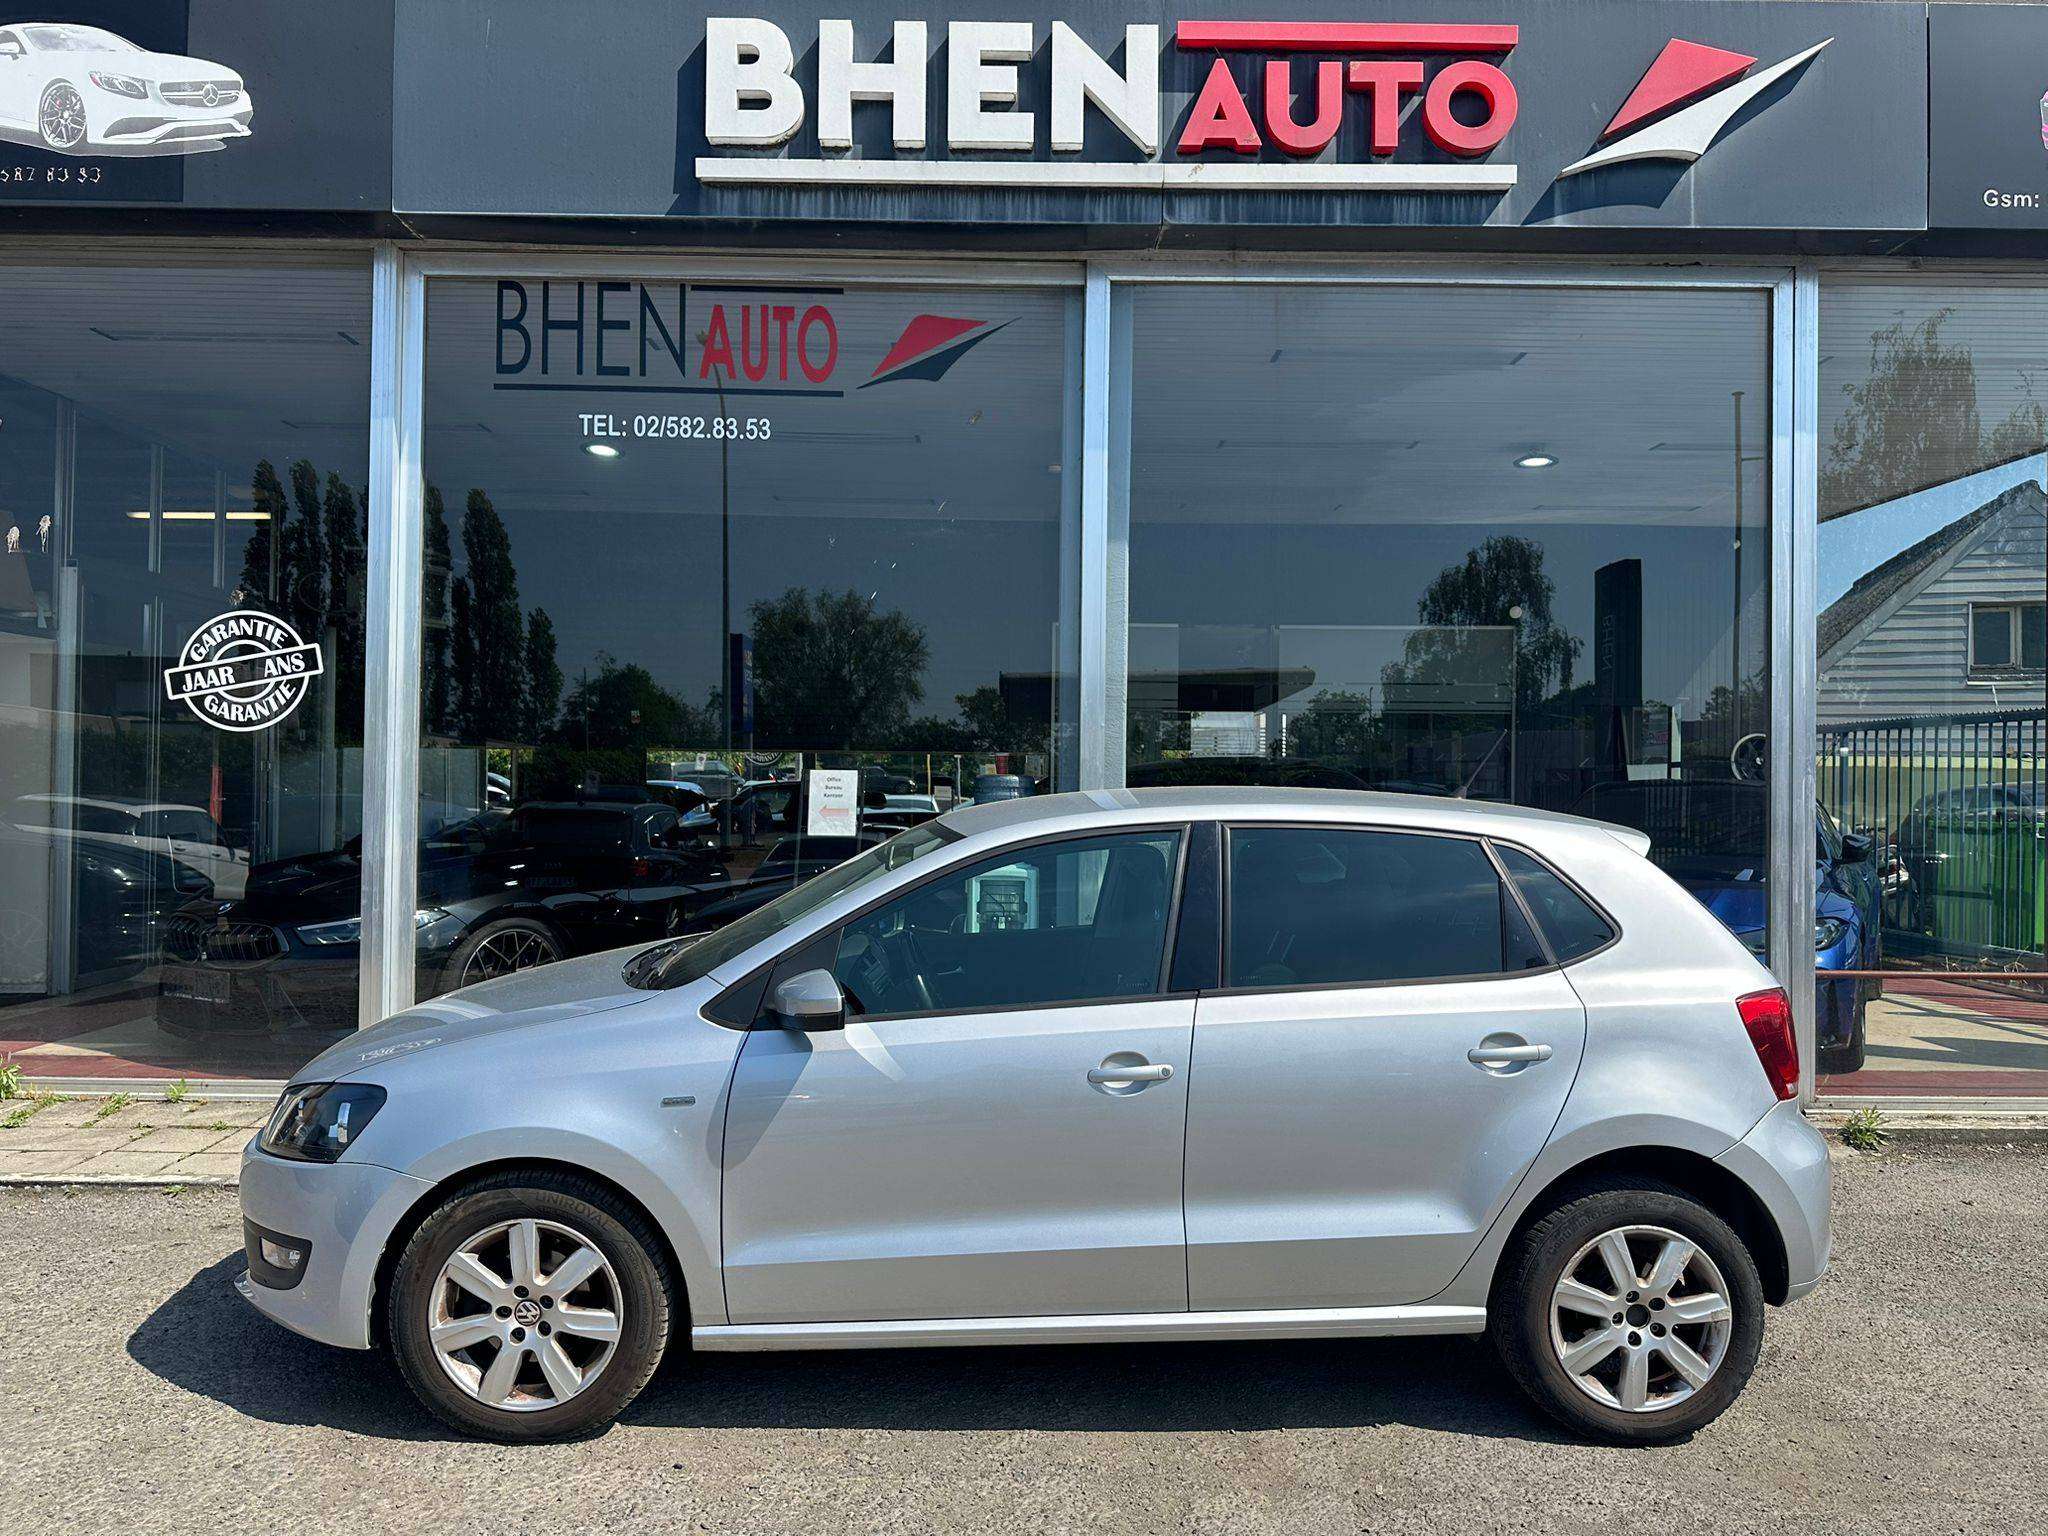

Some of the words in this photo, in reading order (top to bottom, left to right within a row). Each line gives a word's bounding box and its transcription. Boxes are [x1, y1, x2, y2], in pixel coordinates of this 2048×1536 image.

[704, 17, 1160, 155] BHEN
[1176, 57, 1519, 157] AUTO
[1983, 189, 2040, 208] Gsm:
[495, 280, 687, 378] BHEN
[700, 304, 839, 383] AUTO
[578, 414, 627, 437] TEL:
[633, 415, 772, 440] 02/582.83.53
[190, 618, 289, 662] GARANTIE
[182, 666, 236, 692] JAAR
[264, 653, 306, 678] ANS
[204, 679, 297, 722] GARANTIE
